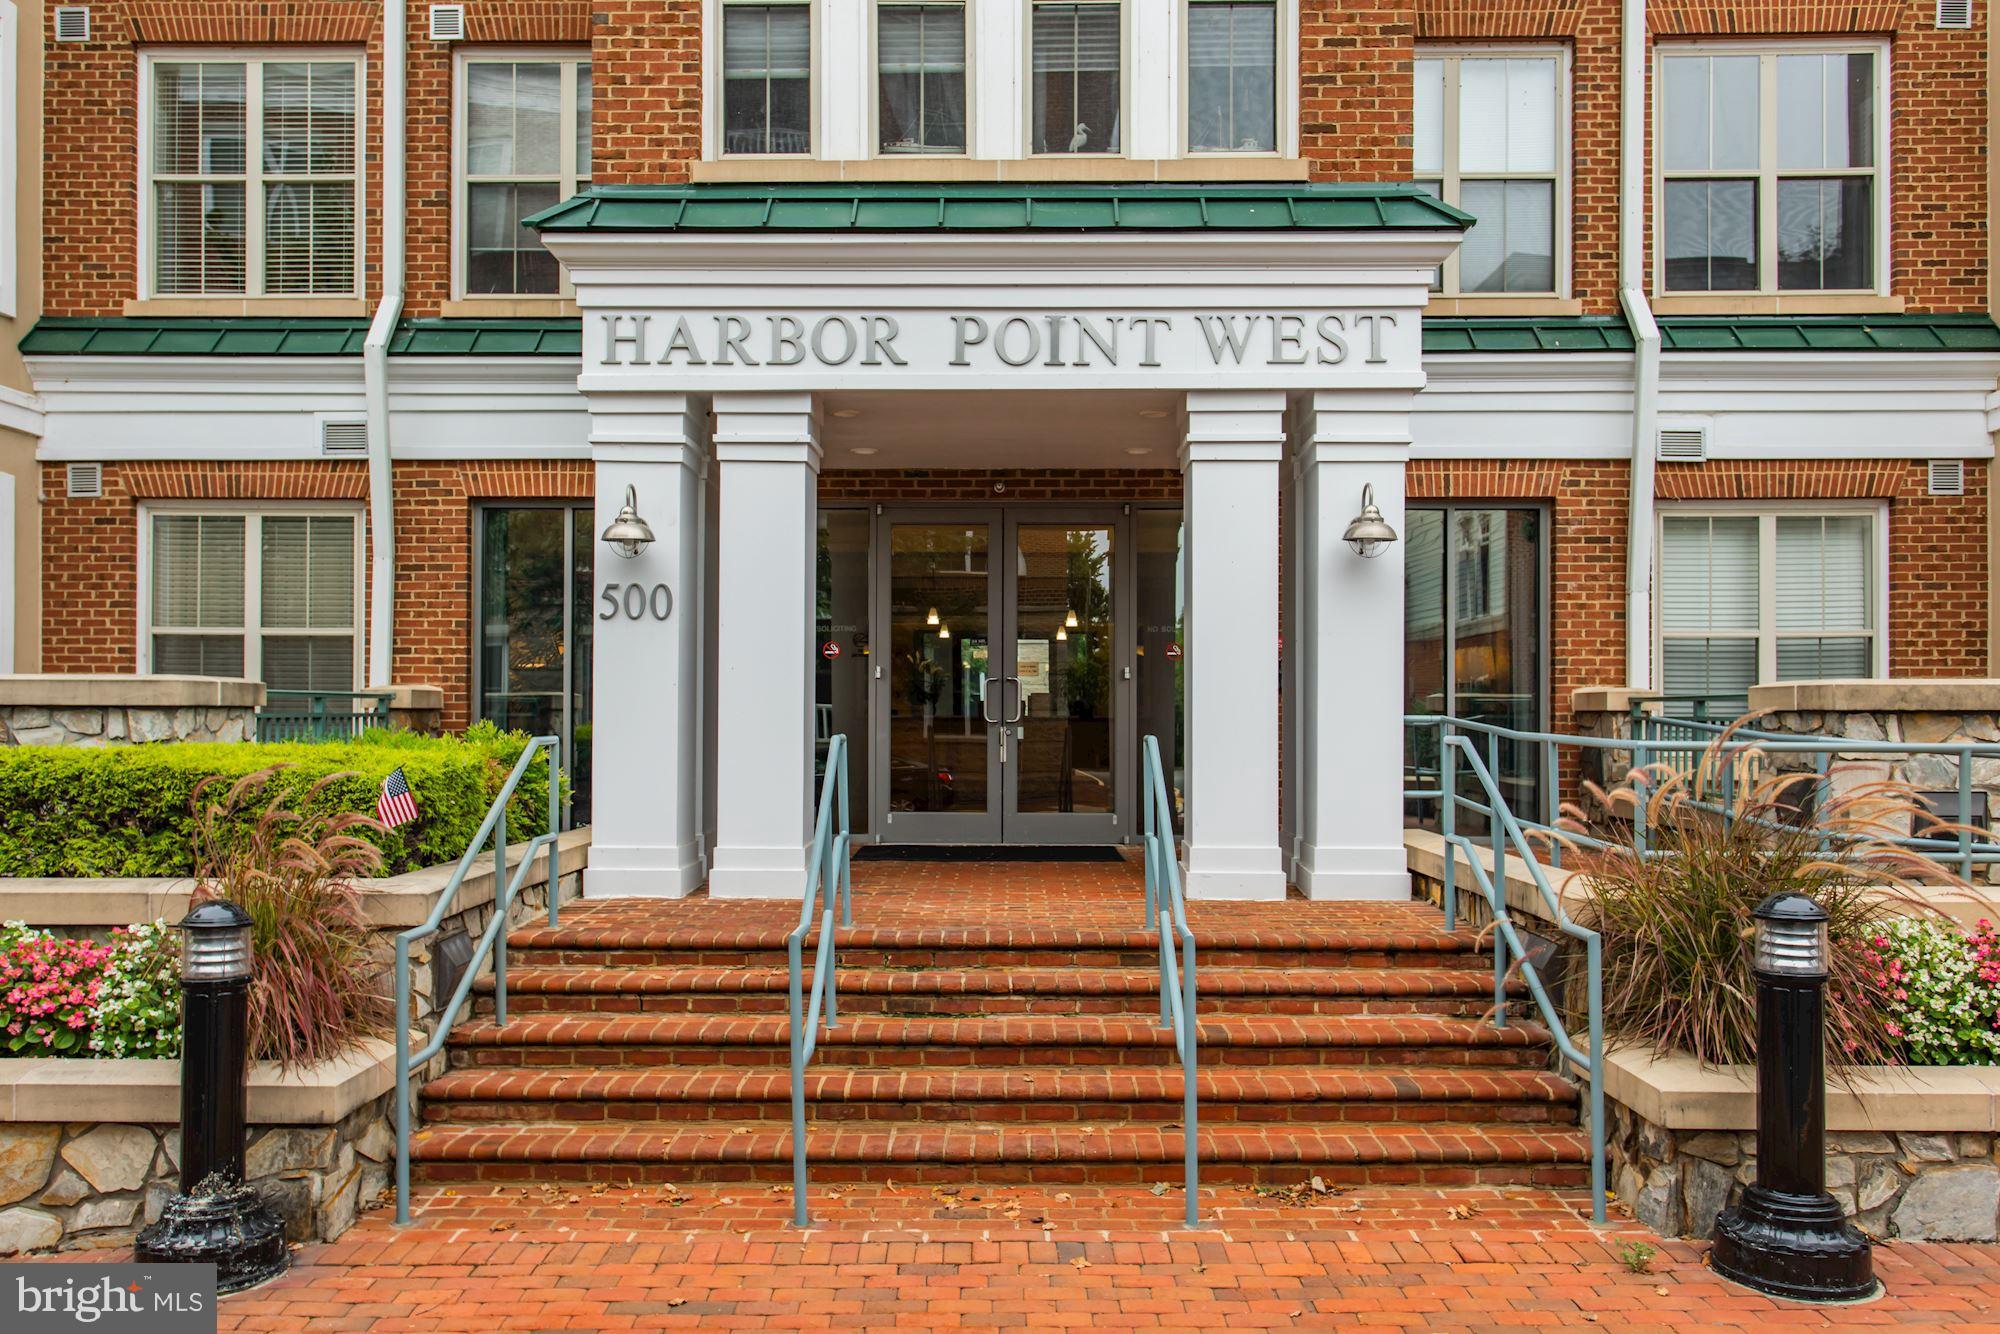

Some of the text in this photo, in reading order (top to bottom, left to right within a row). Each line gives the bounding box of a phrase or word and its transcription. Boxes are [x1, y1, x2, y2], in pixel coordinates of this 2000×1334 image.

[600, 312, 1397, 367] HARBOR POINT WEST
[599, 583, 673, 621] 500
